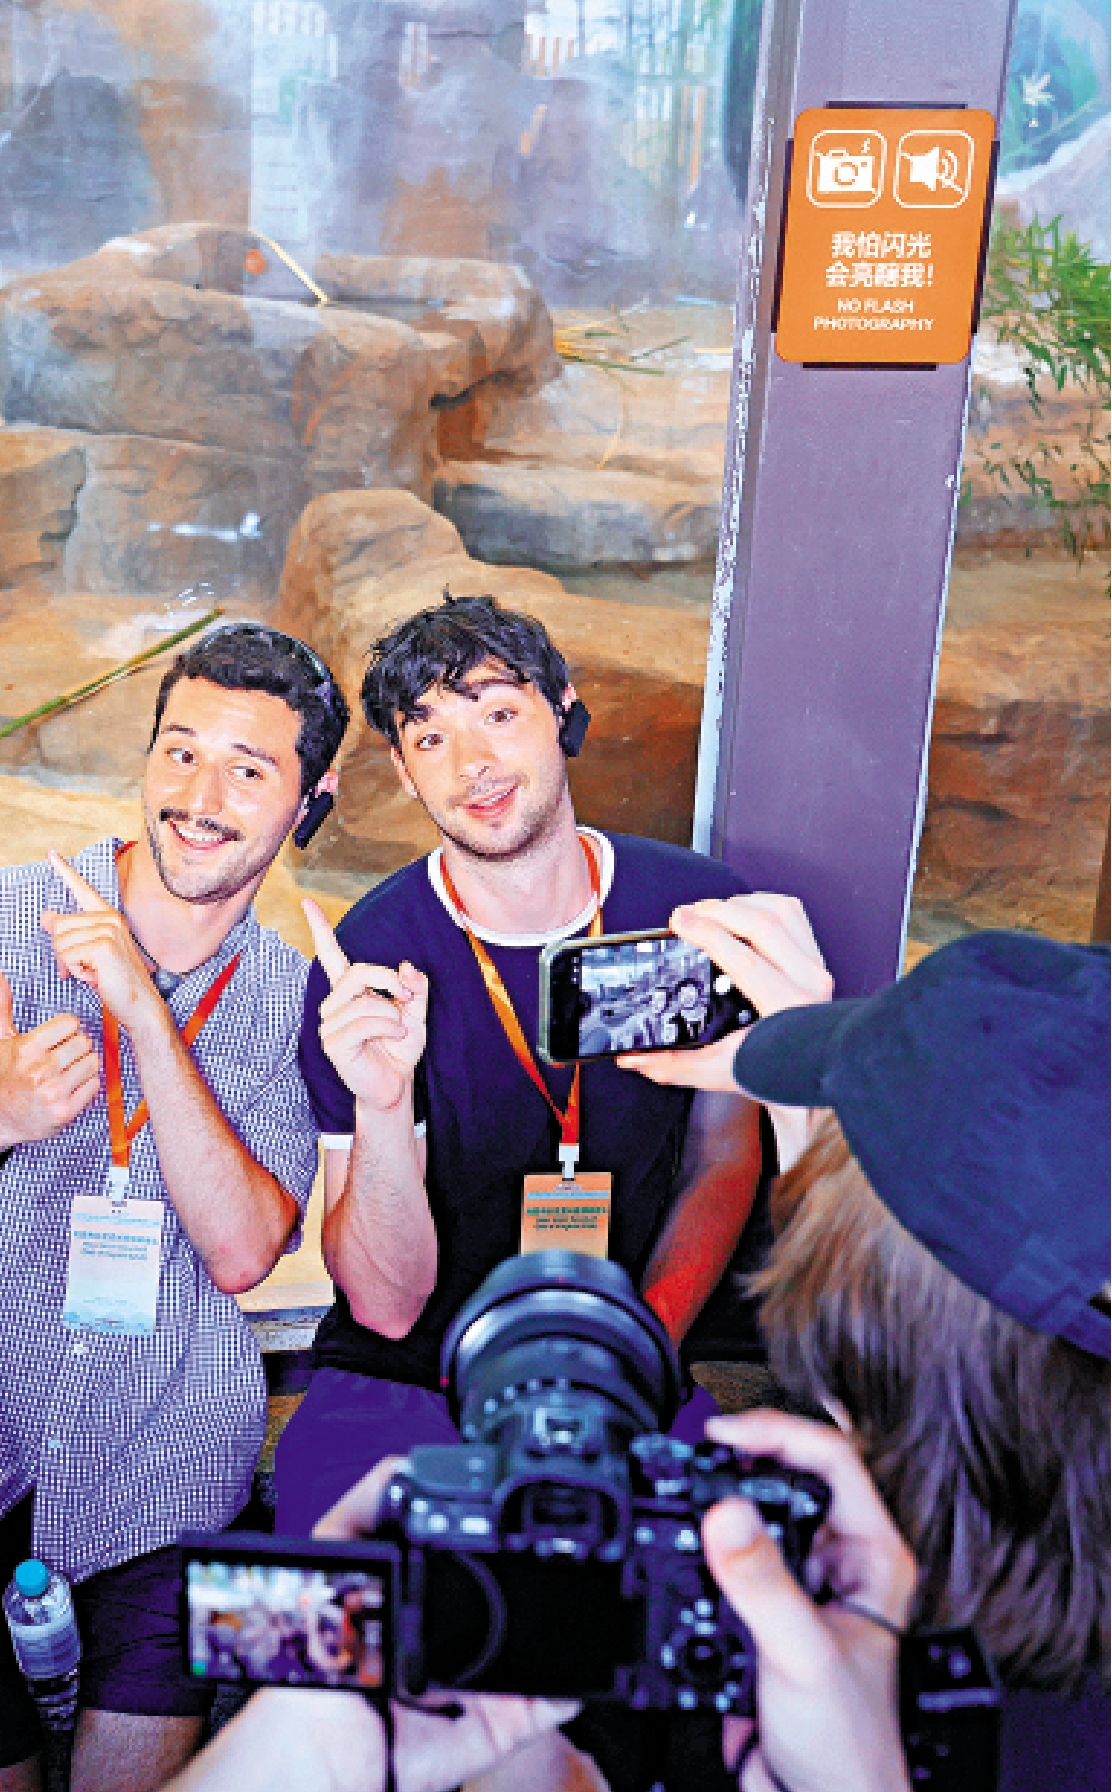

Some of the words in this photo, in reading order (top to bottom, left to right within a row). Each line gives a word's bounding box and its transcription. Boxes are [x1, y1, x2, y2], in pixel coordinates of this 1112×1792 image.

[831, 231, 932, 259] 我怕闪光
[837, 298, 862, 313] NO
[864, 298, 914, 314] FLASH
[813, 316, 934, 331] PHOTOGRAPHY
